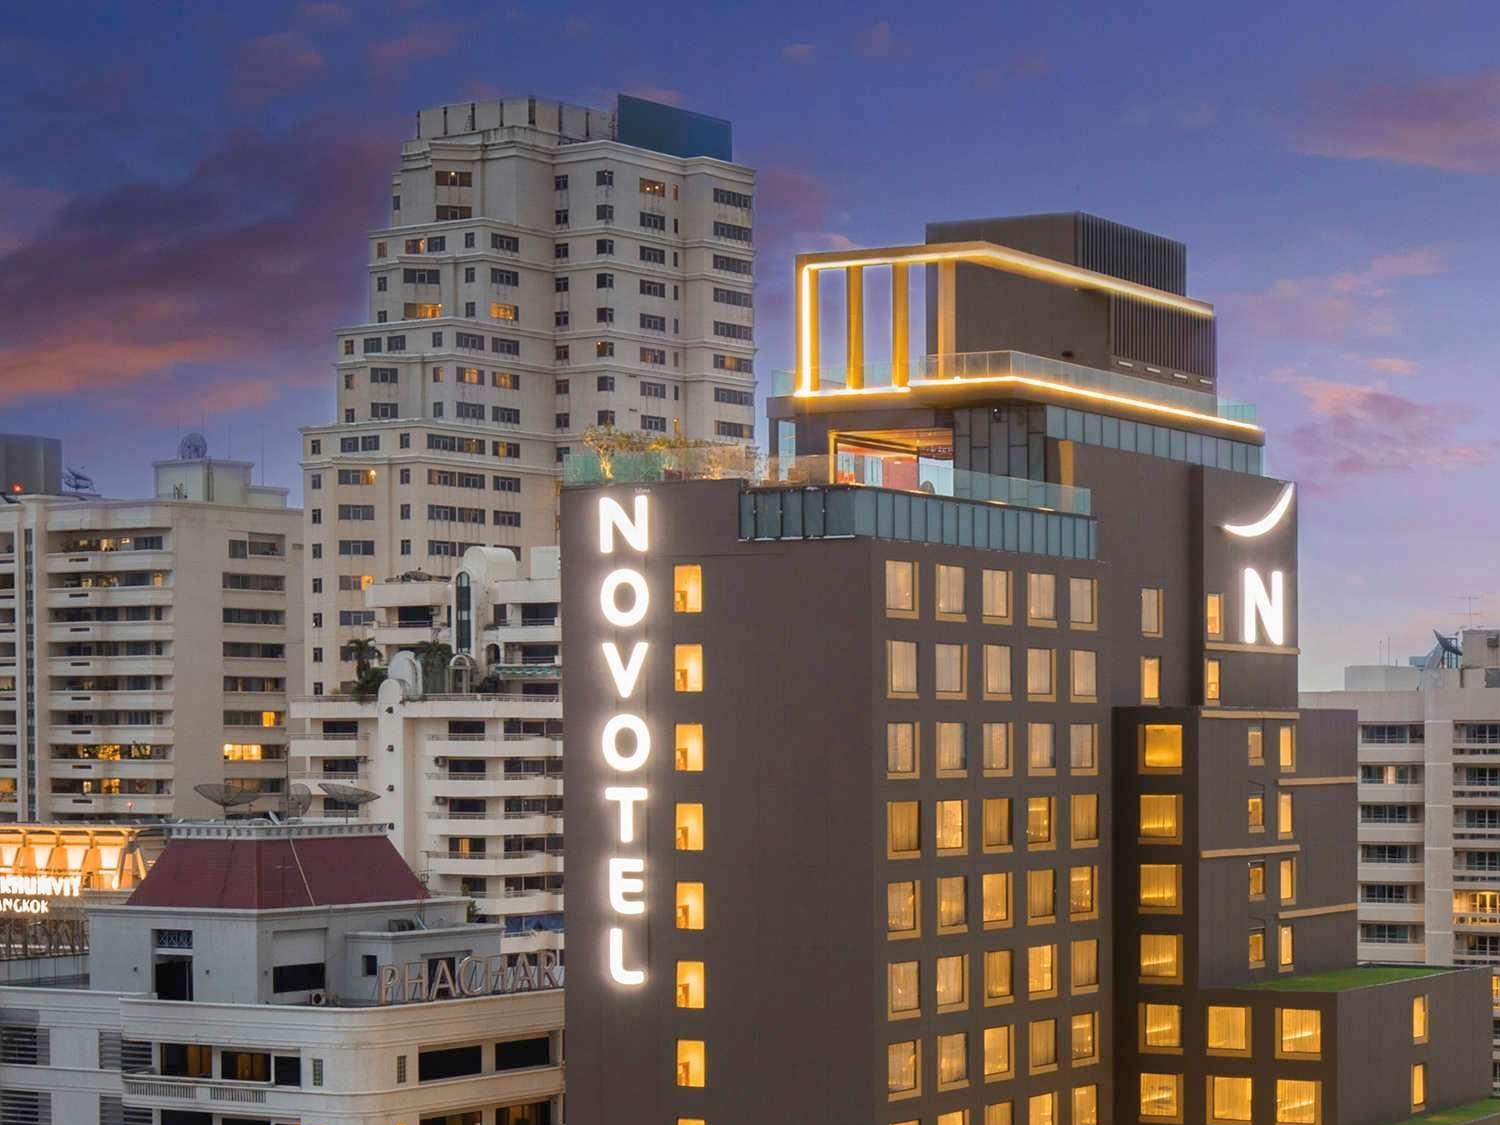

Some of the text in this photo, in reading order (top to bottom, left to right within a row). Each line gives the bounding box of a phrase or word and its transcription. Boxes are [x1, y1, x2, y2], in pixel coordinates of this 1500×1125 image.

[1243, 566, 1284, 646] N
[598, 494, 651, 986] NOVOTEL
[0, 897, 49, 914] NGKOK
[379, 949, 560, 1005] PHACHAR
